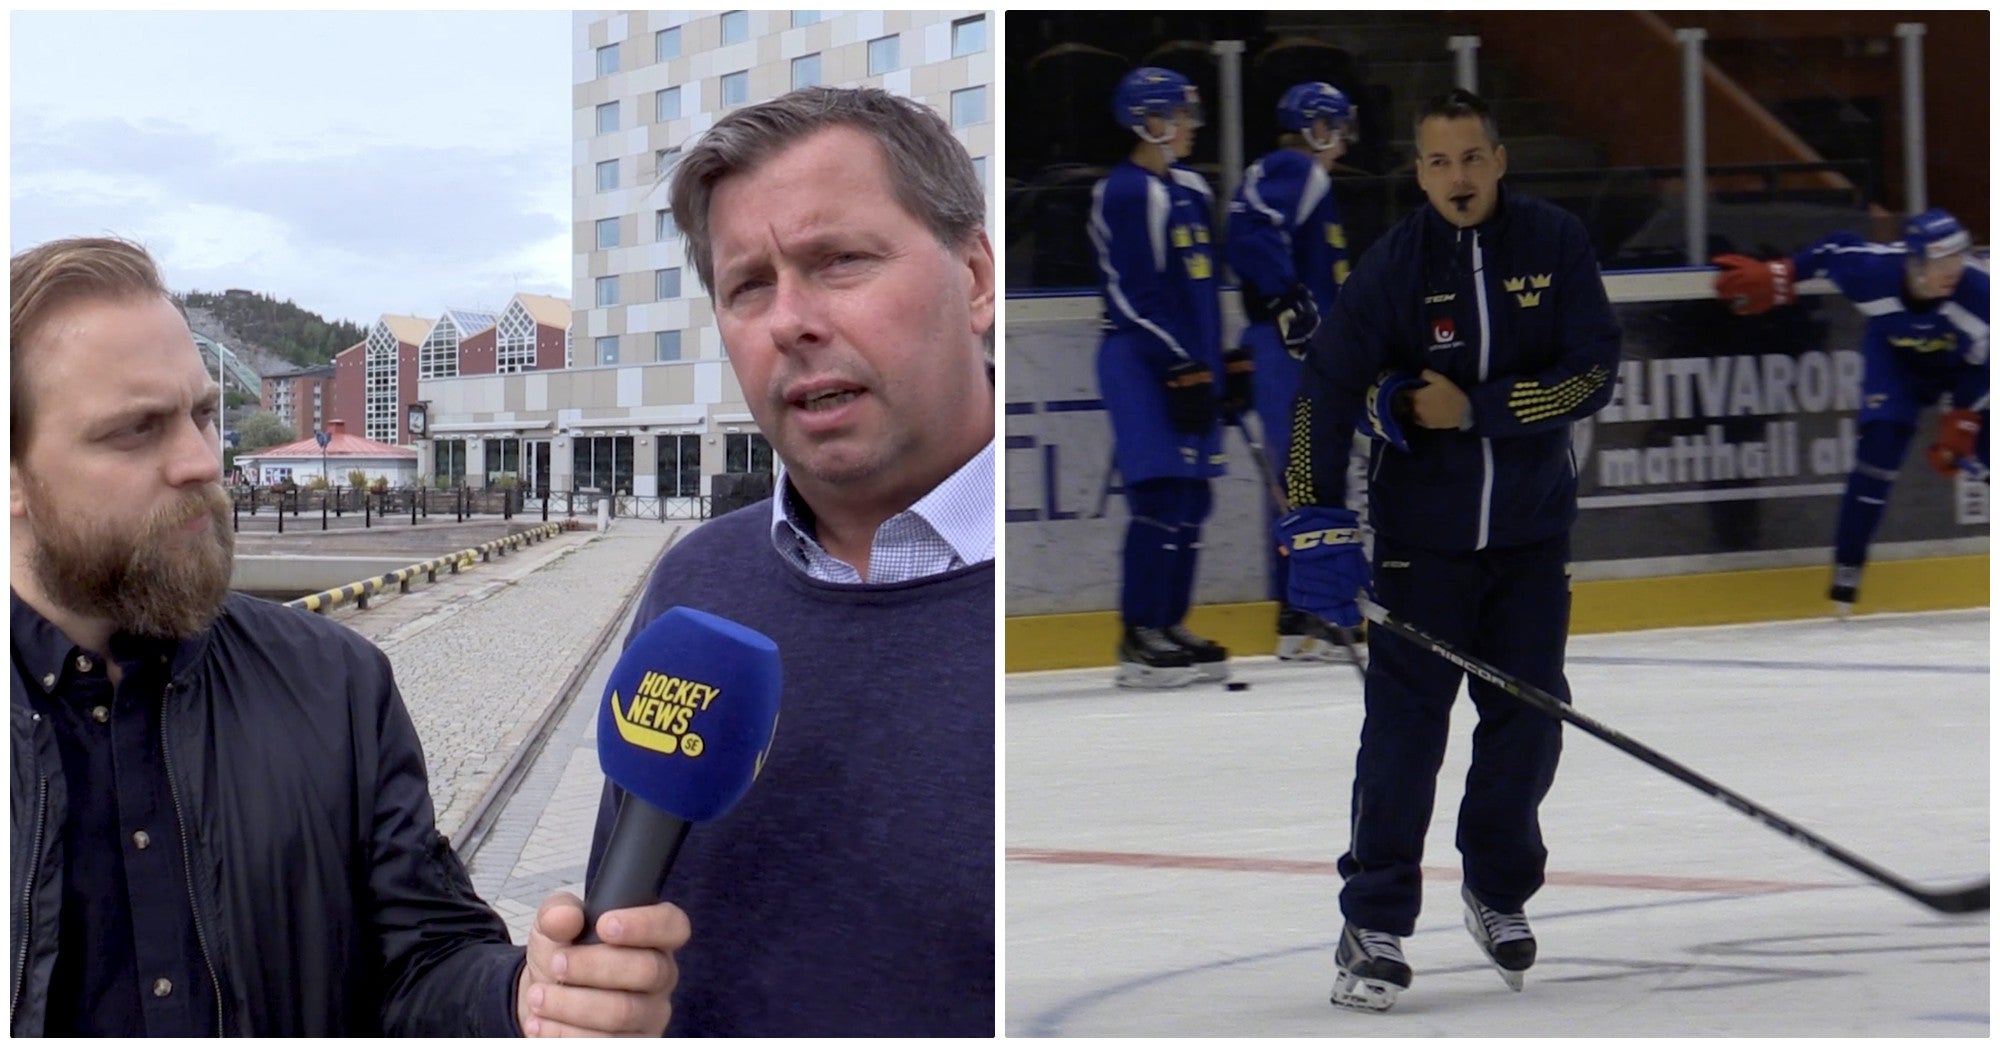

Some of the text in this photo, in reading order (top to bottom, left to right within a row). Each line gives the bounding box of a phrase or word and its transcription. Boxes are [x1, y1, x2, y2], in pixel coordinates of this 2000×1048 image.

[1597, 350, 1865, 422] ELITVAROR
[1599, 422, 1798, 487] matthall
[637, 670, 720, 711] HOCKEY
[626, 694, 694, 735] NEWS
[684, 737, 699, 751] SE
